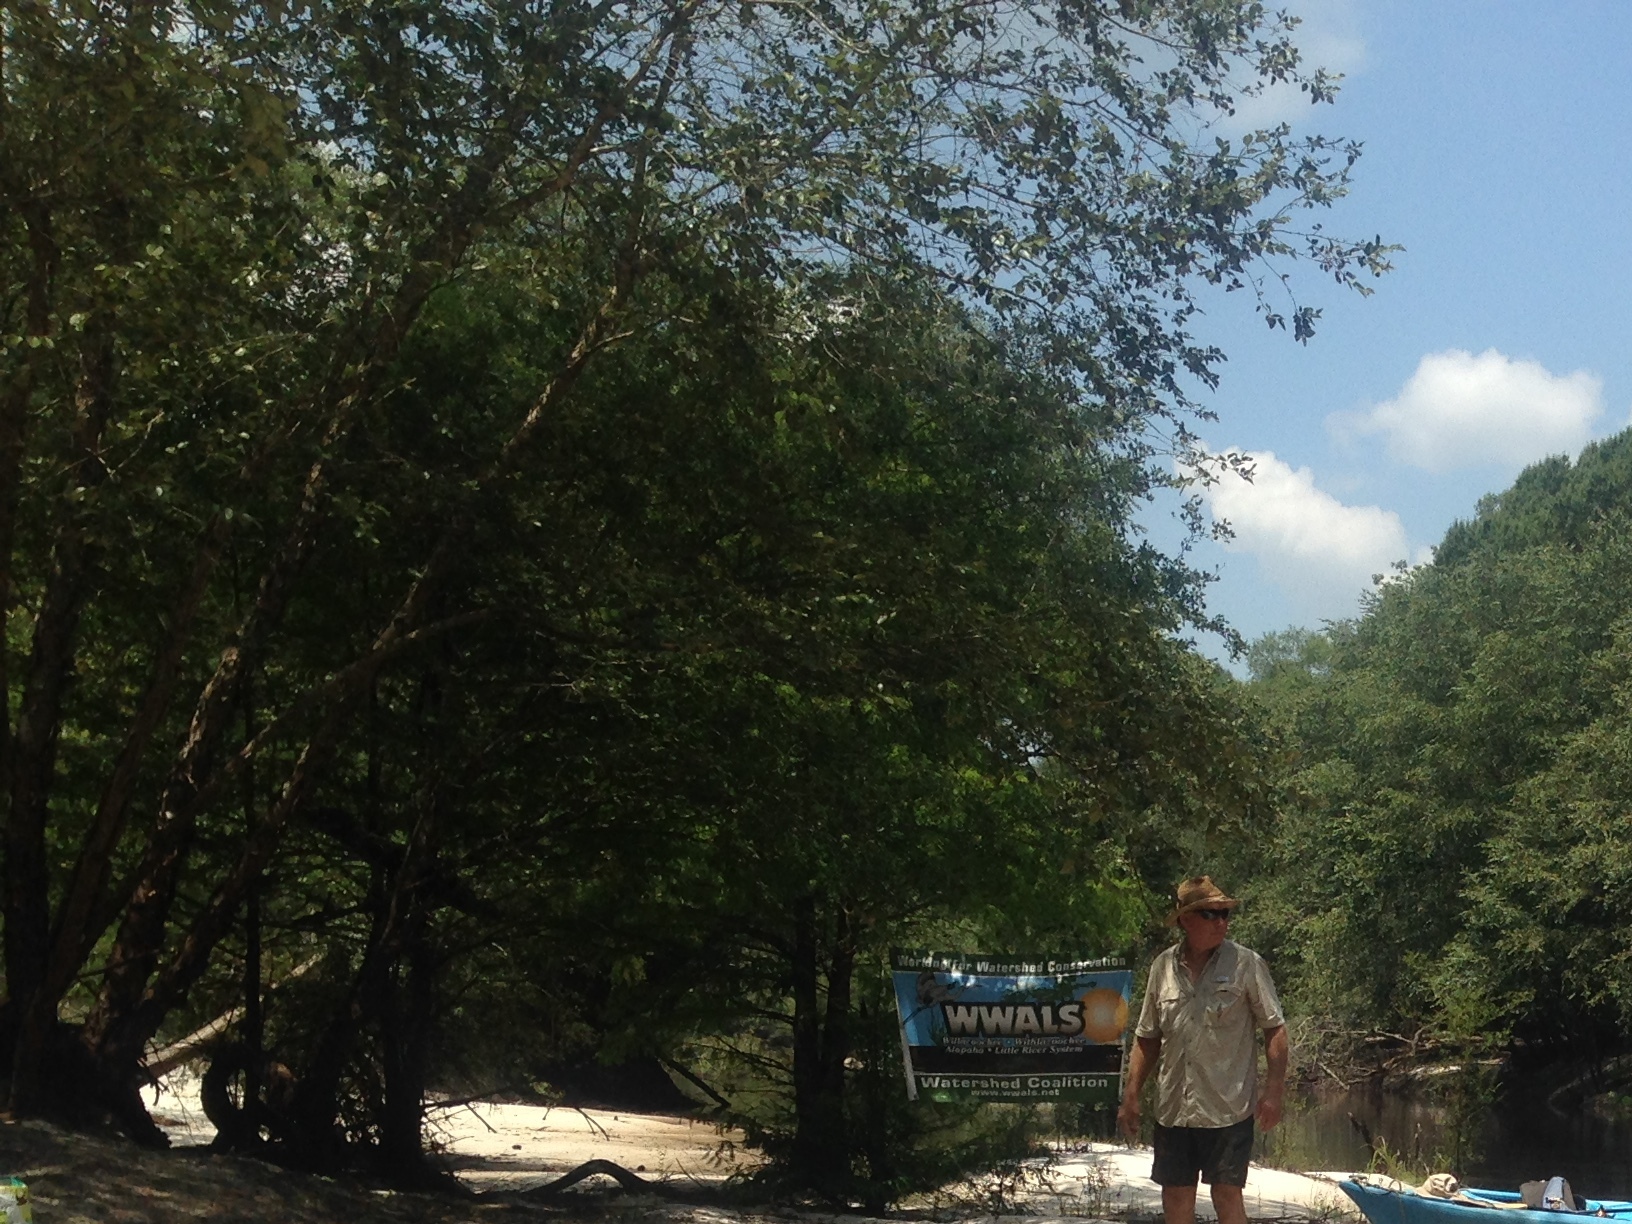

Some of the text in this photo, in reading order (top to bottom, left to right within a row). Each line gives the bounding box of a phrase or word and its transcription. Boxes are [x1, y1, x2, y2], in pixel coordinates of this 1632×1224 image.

[976, 961, 1044, 974] Watershed
[1047, 956, 1127, 973] Conservation
[944, 1003, 1083, 1036] WWALS
[994, 1046, 1019, 1055] Little
[1021, 1046, 1047, 1055] River
[1049, 1046, 1084, 1055] System
[920, 1076, 1109, 1090] Watershed Coalition
[970, 1088, 1060, 1097] www.wwals.net
